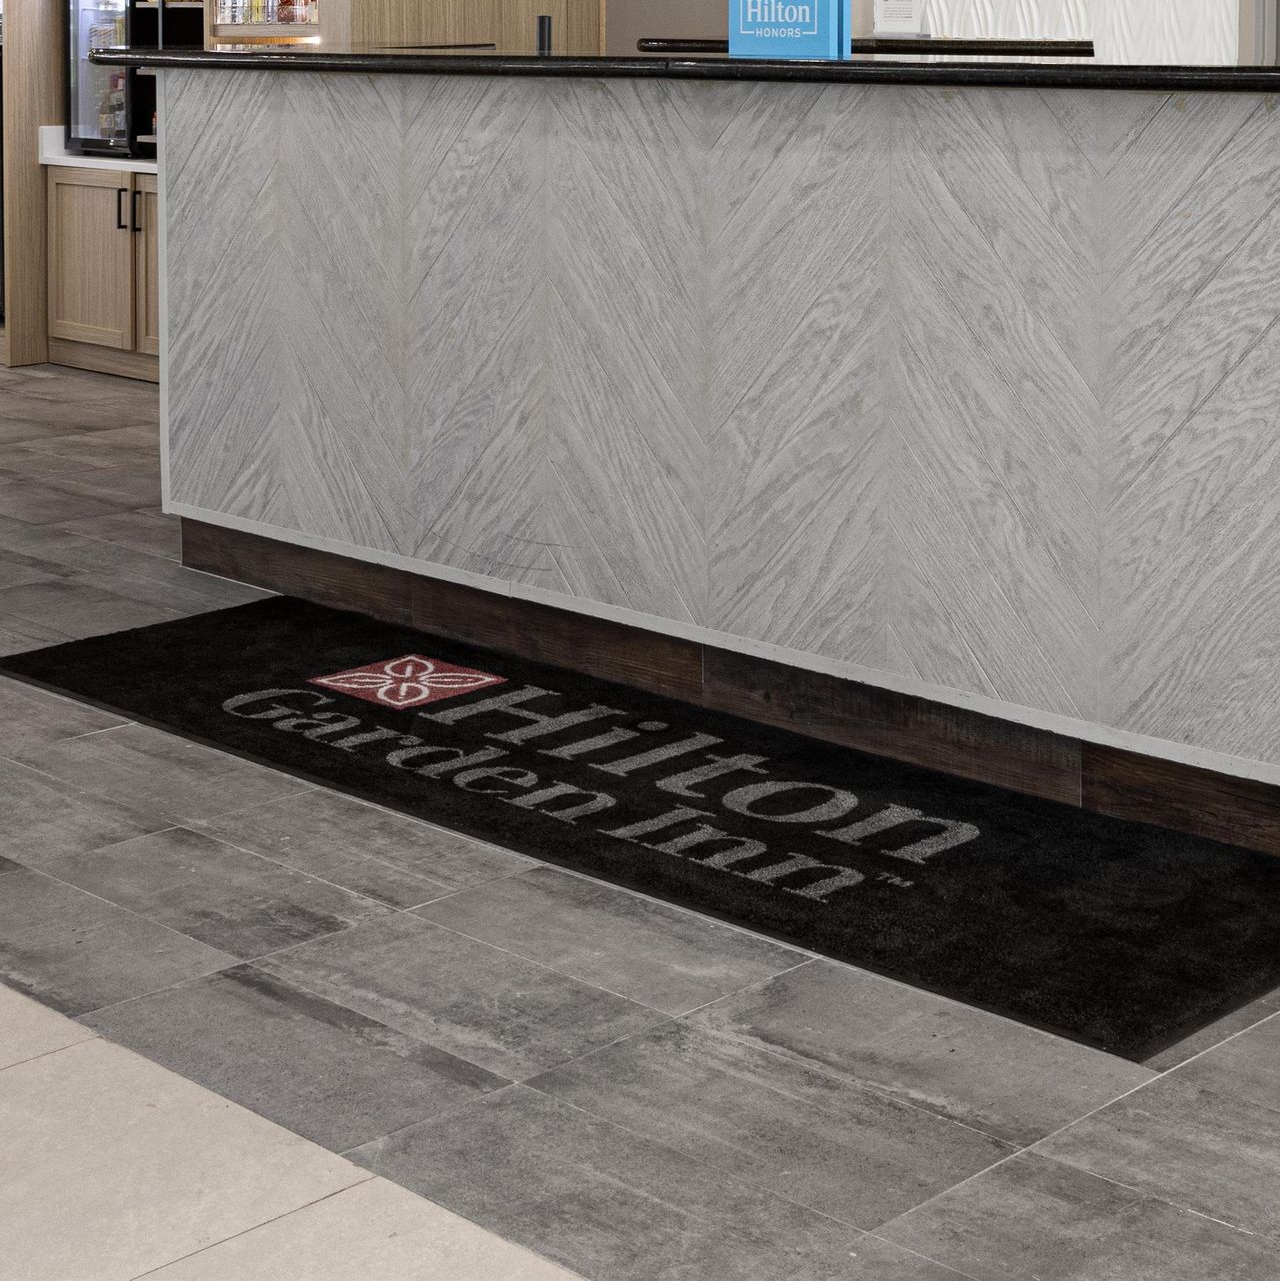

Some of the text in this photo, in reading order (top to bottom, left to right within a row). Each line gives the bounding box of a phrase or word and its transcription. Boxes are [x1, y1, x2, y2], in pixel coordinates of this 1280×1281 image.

[755, 27, 802, 38] HONORS
[221, 687, 619, 825] Garden
[597, 807, 867, 903] Inn
[420, 683, 982, 866] Hilton
